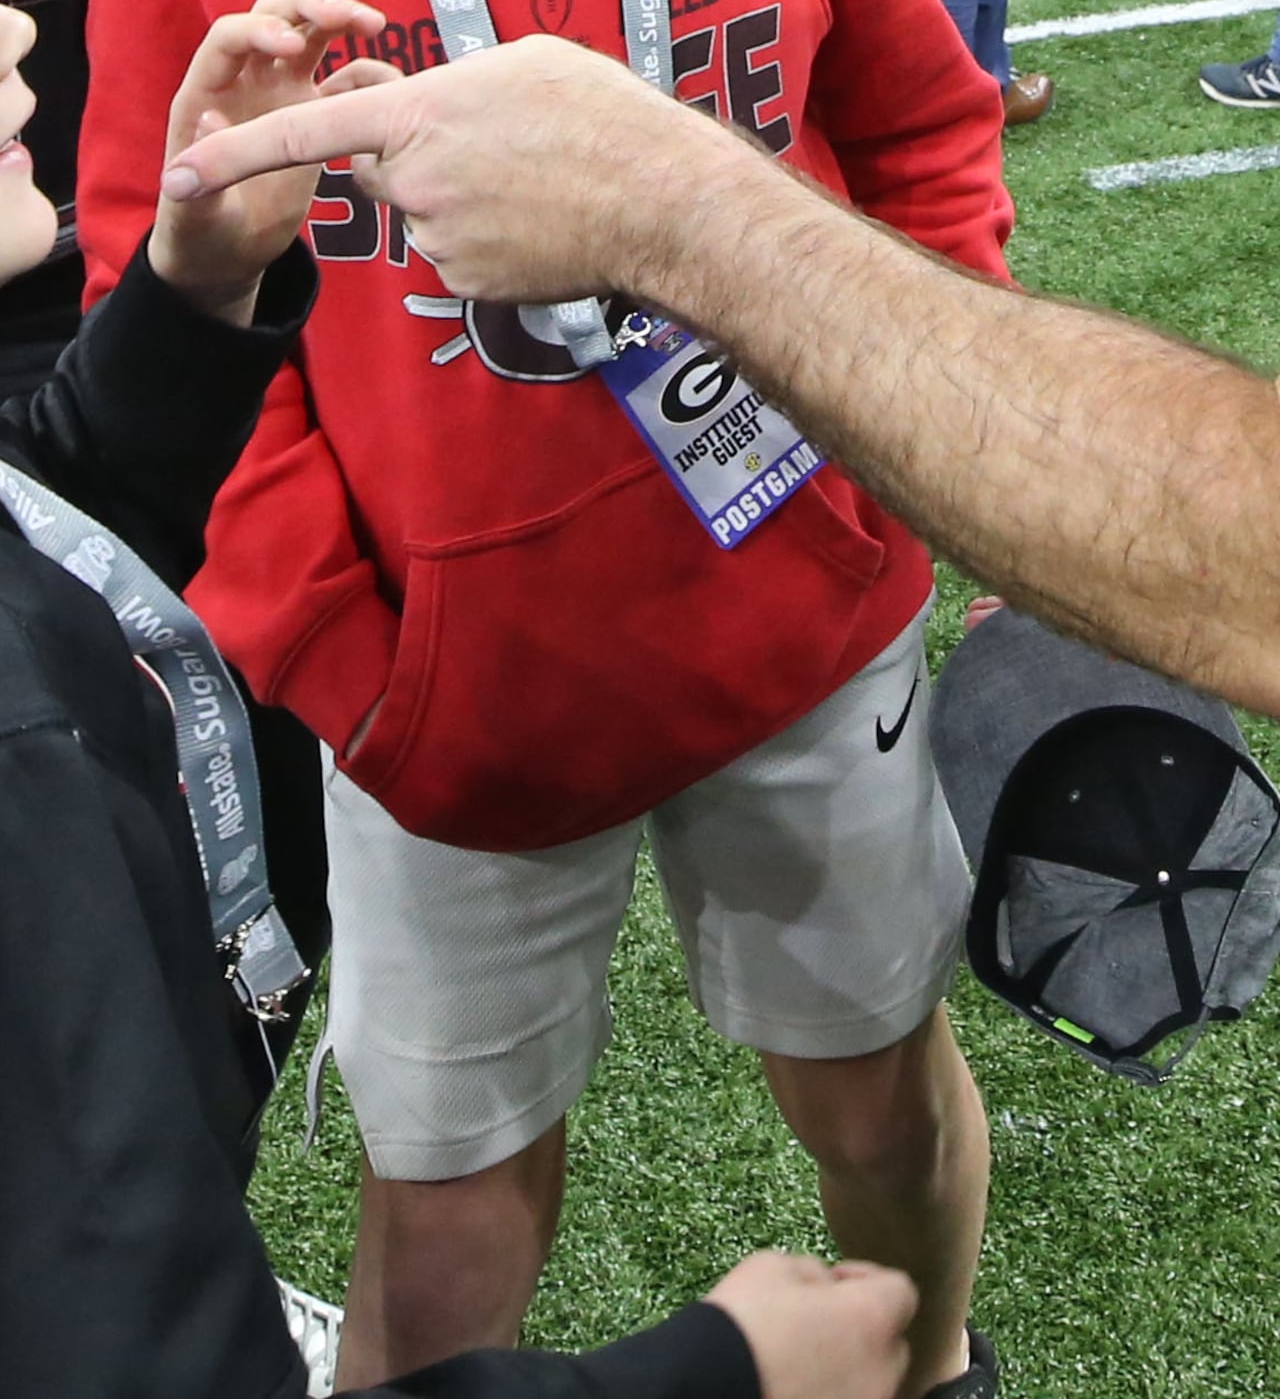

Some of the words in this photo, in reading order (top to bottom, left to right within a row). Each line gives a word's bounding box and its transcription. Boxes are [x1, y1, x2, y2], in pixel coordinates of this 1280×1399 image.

[711, 414, 764, 467] GUEST
[710, 442, 820, 545] POSTGAM
[175, 646, 226, 741] Sugar
